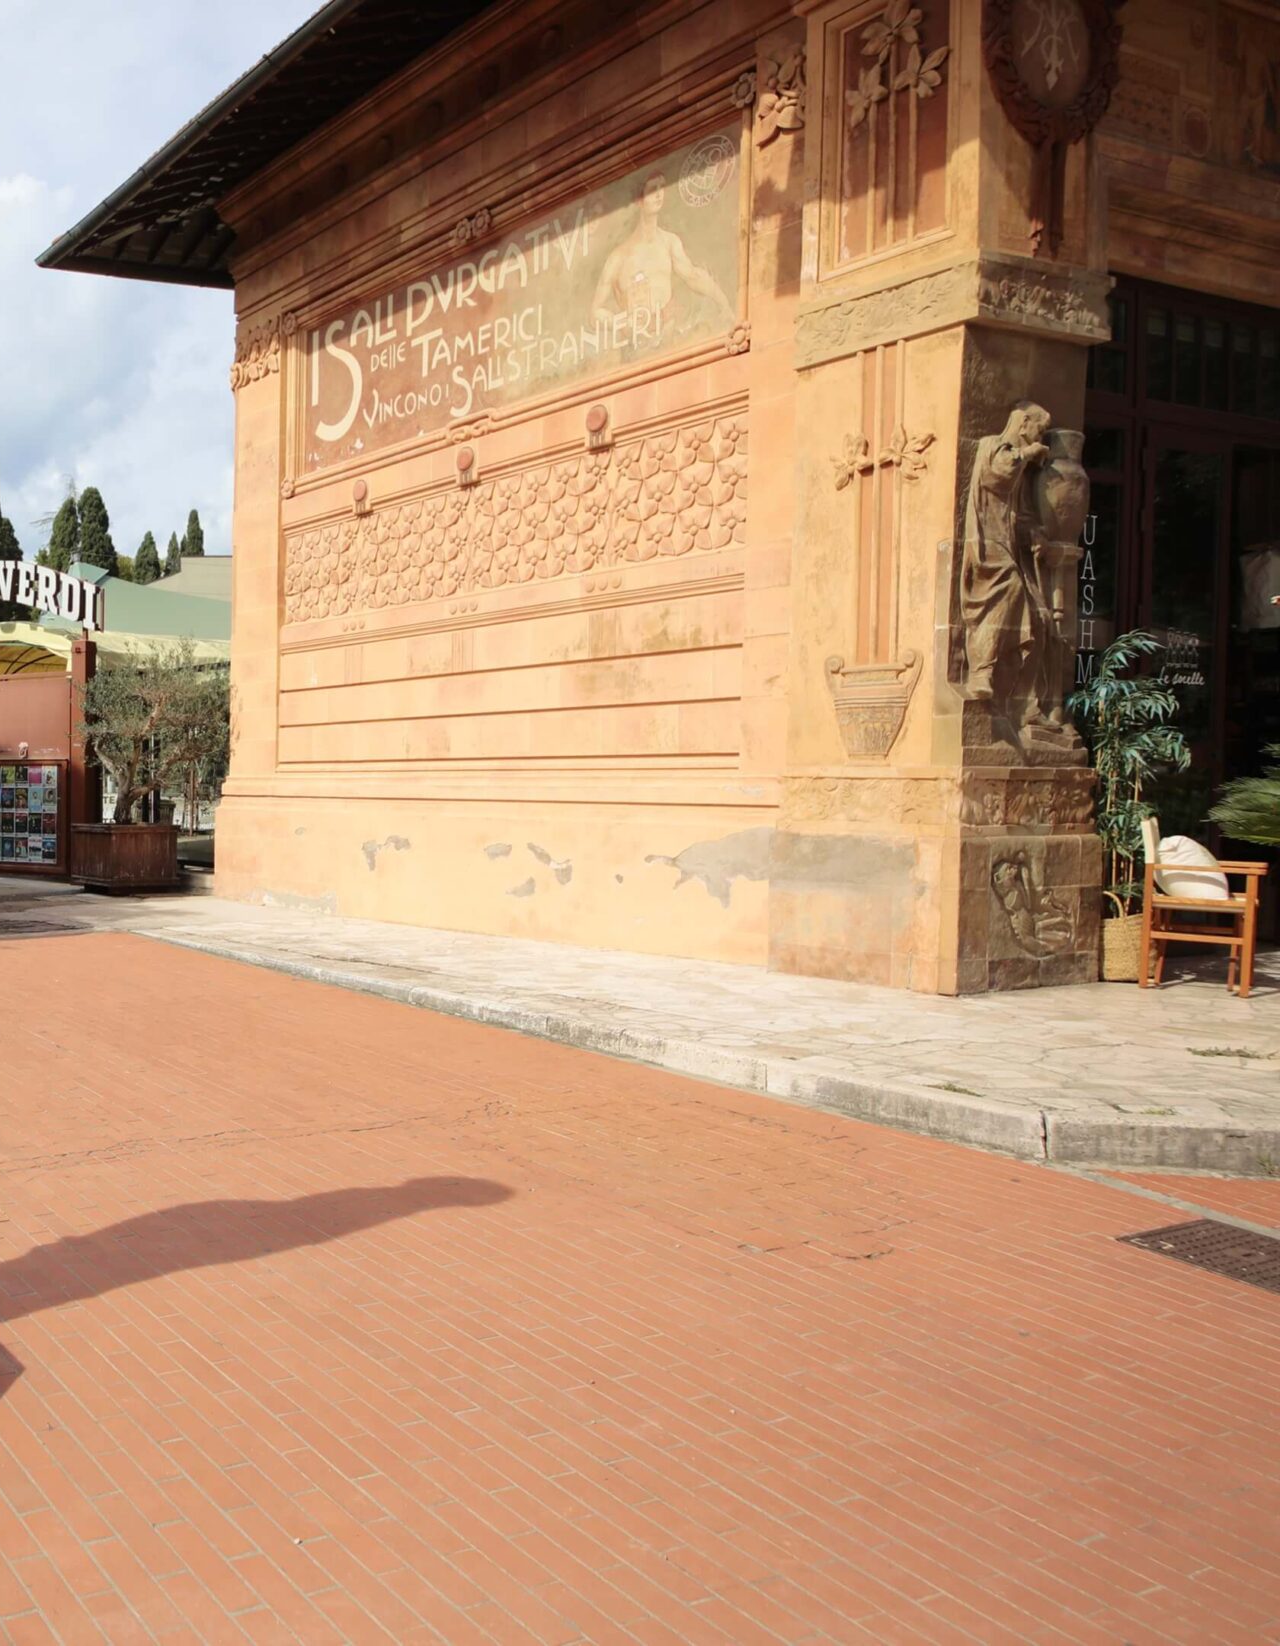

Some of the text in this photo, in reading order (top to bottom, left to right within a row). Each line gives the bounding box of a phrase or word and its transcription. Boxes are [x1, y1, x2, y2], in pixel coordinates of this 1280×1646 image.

[314, 293, 397, 442] SALI
[363, 384, 442, 429] VINCONO
[450, 356, 504, 417] SALI
[507, 302, 664, 382] STRANIERI
[411, 303, 543, 378] TAMERICI
